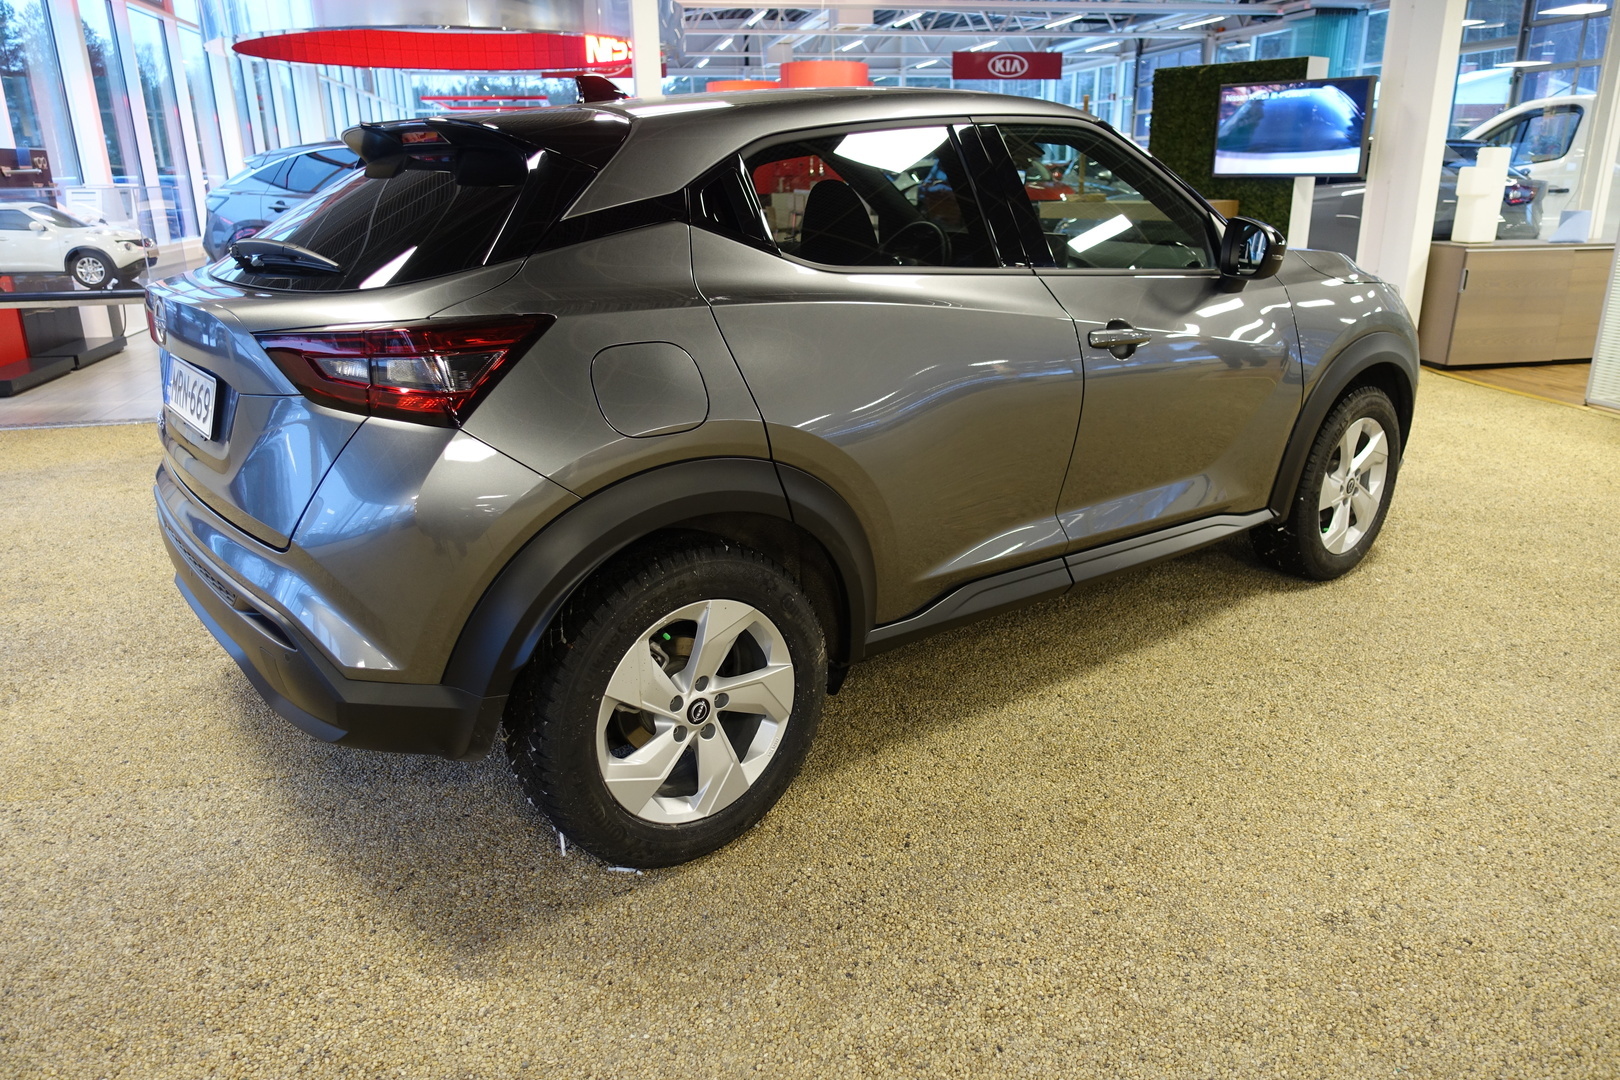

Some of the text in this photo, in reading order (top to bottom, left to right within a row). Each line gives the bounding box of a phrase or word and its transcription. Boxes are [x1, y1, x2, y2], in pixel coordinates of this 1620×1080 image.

[585, 35, 632, 63] NIS
[995, 59, 1022, 72] KIA
[171, 367, 211, 424] MRN-669
